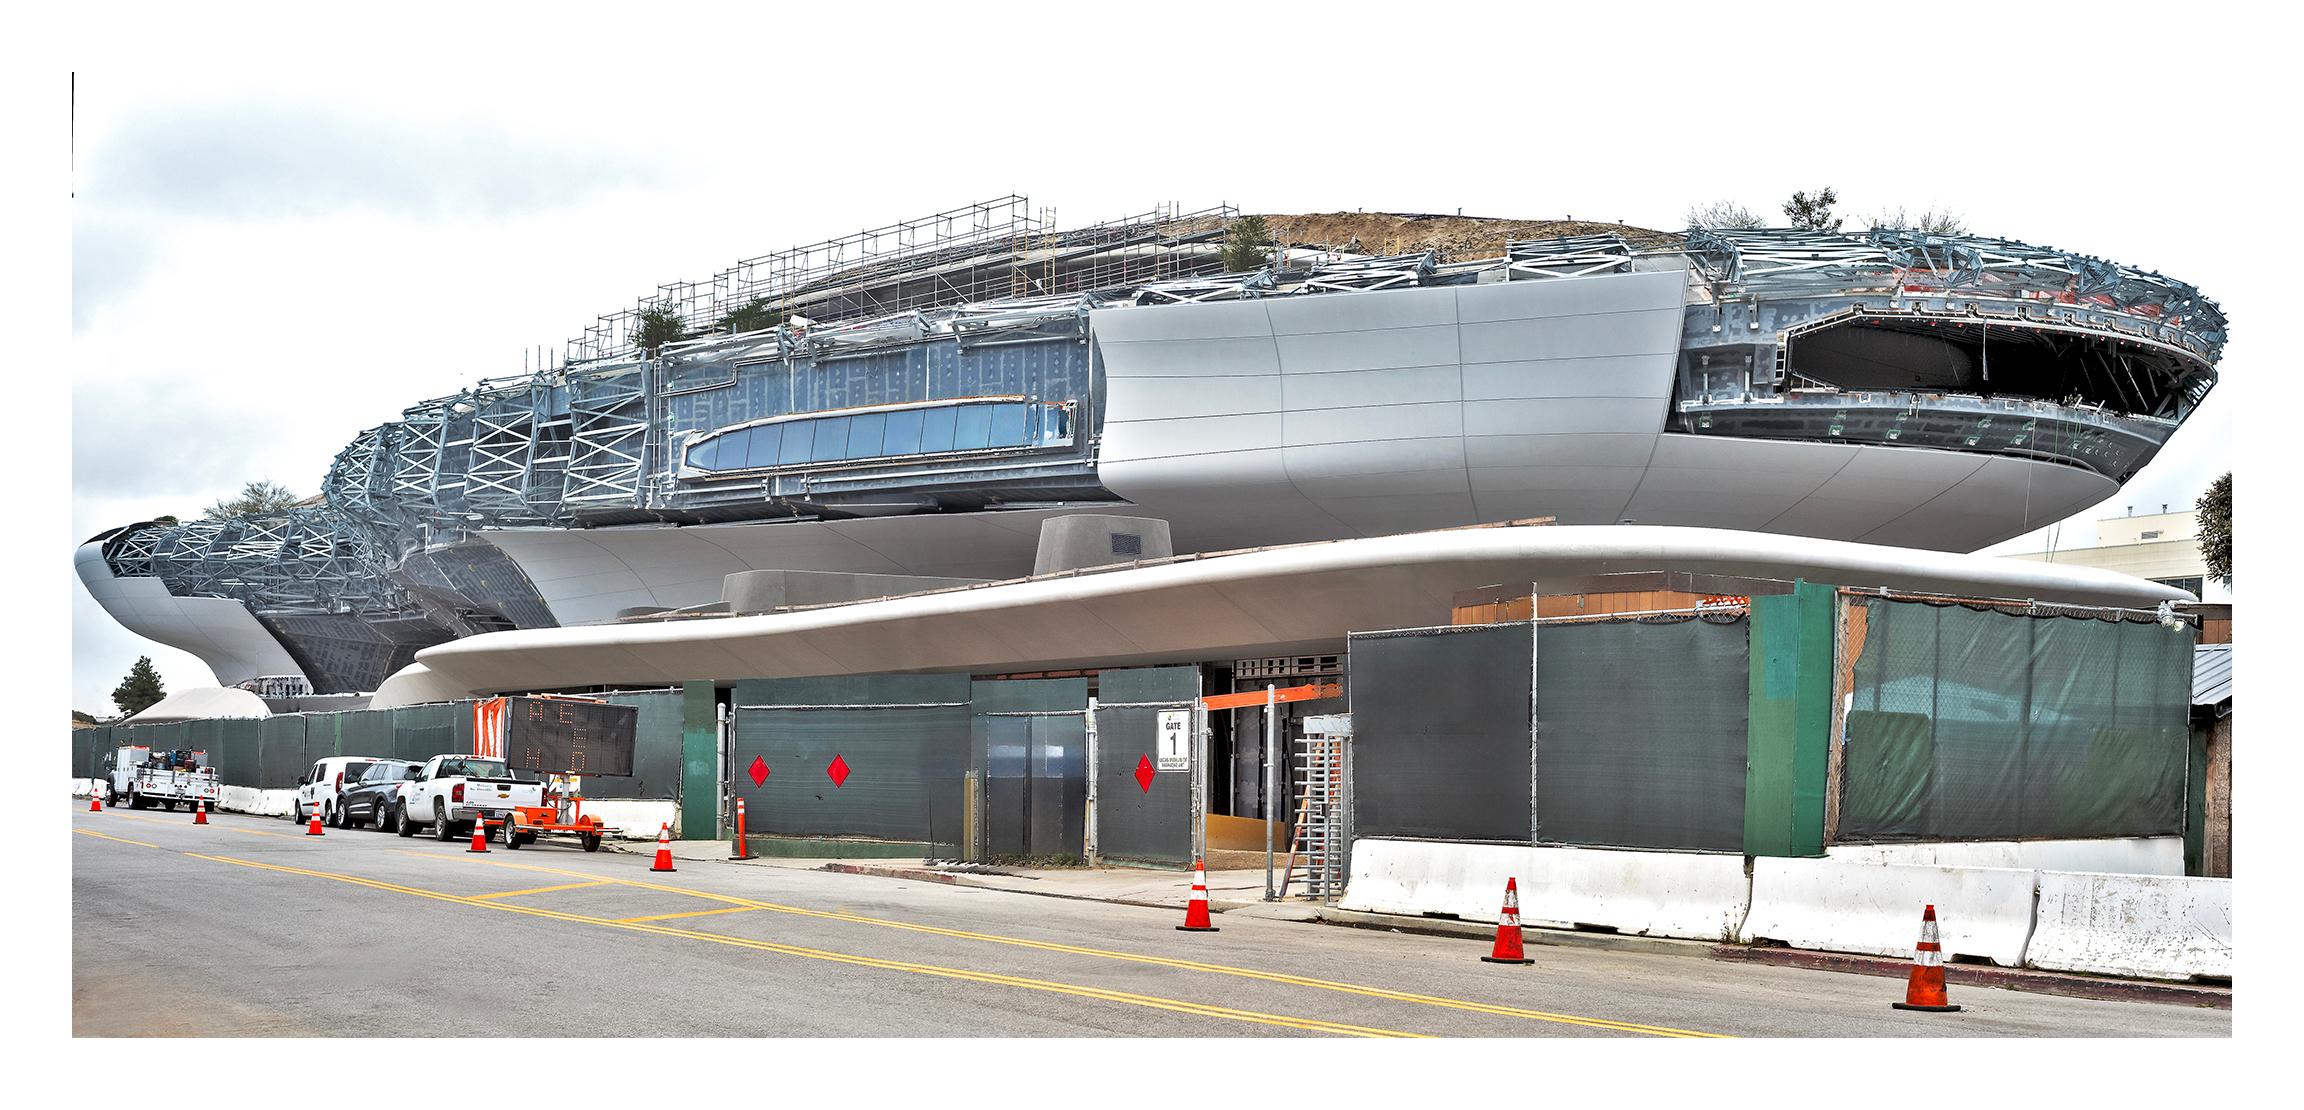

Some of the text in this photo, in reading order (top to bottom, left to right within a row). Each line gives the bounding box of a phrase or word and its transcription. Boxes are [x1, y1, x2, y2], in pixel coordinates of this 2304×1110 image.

[529, 701, 573, 723] A E
[1165, 722, 1181, 730] GATE
[573, 728, 587, 748] E
[1170, 732, 1176, 755] 1
[526, 748, 540, 768] H
